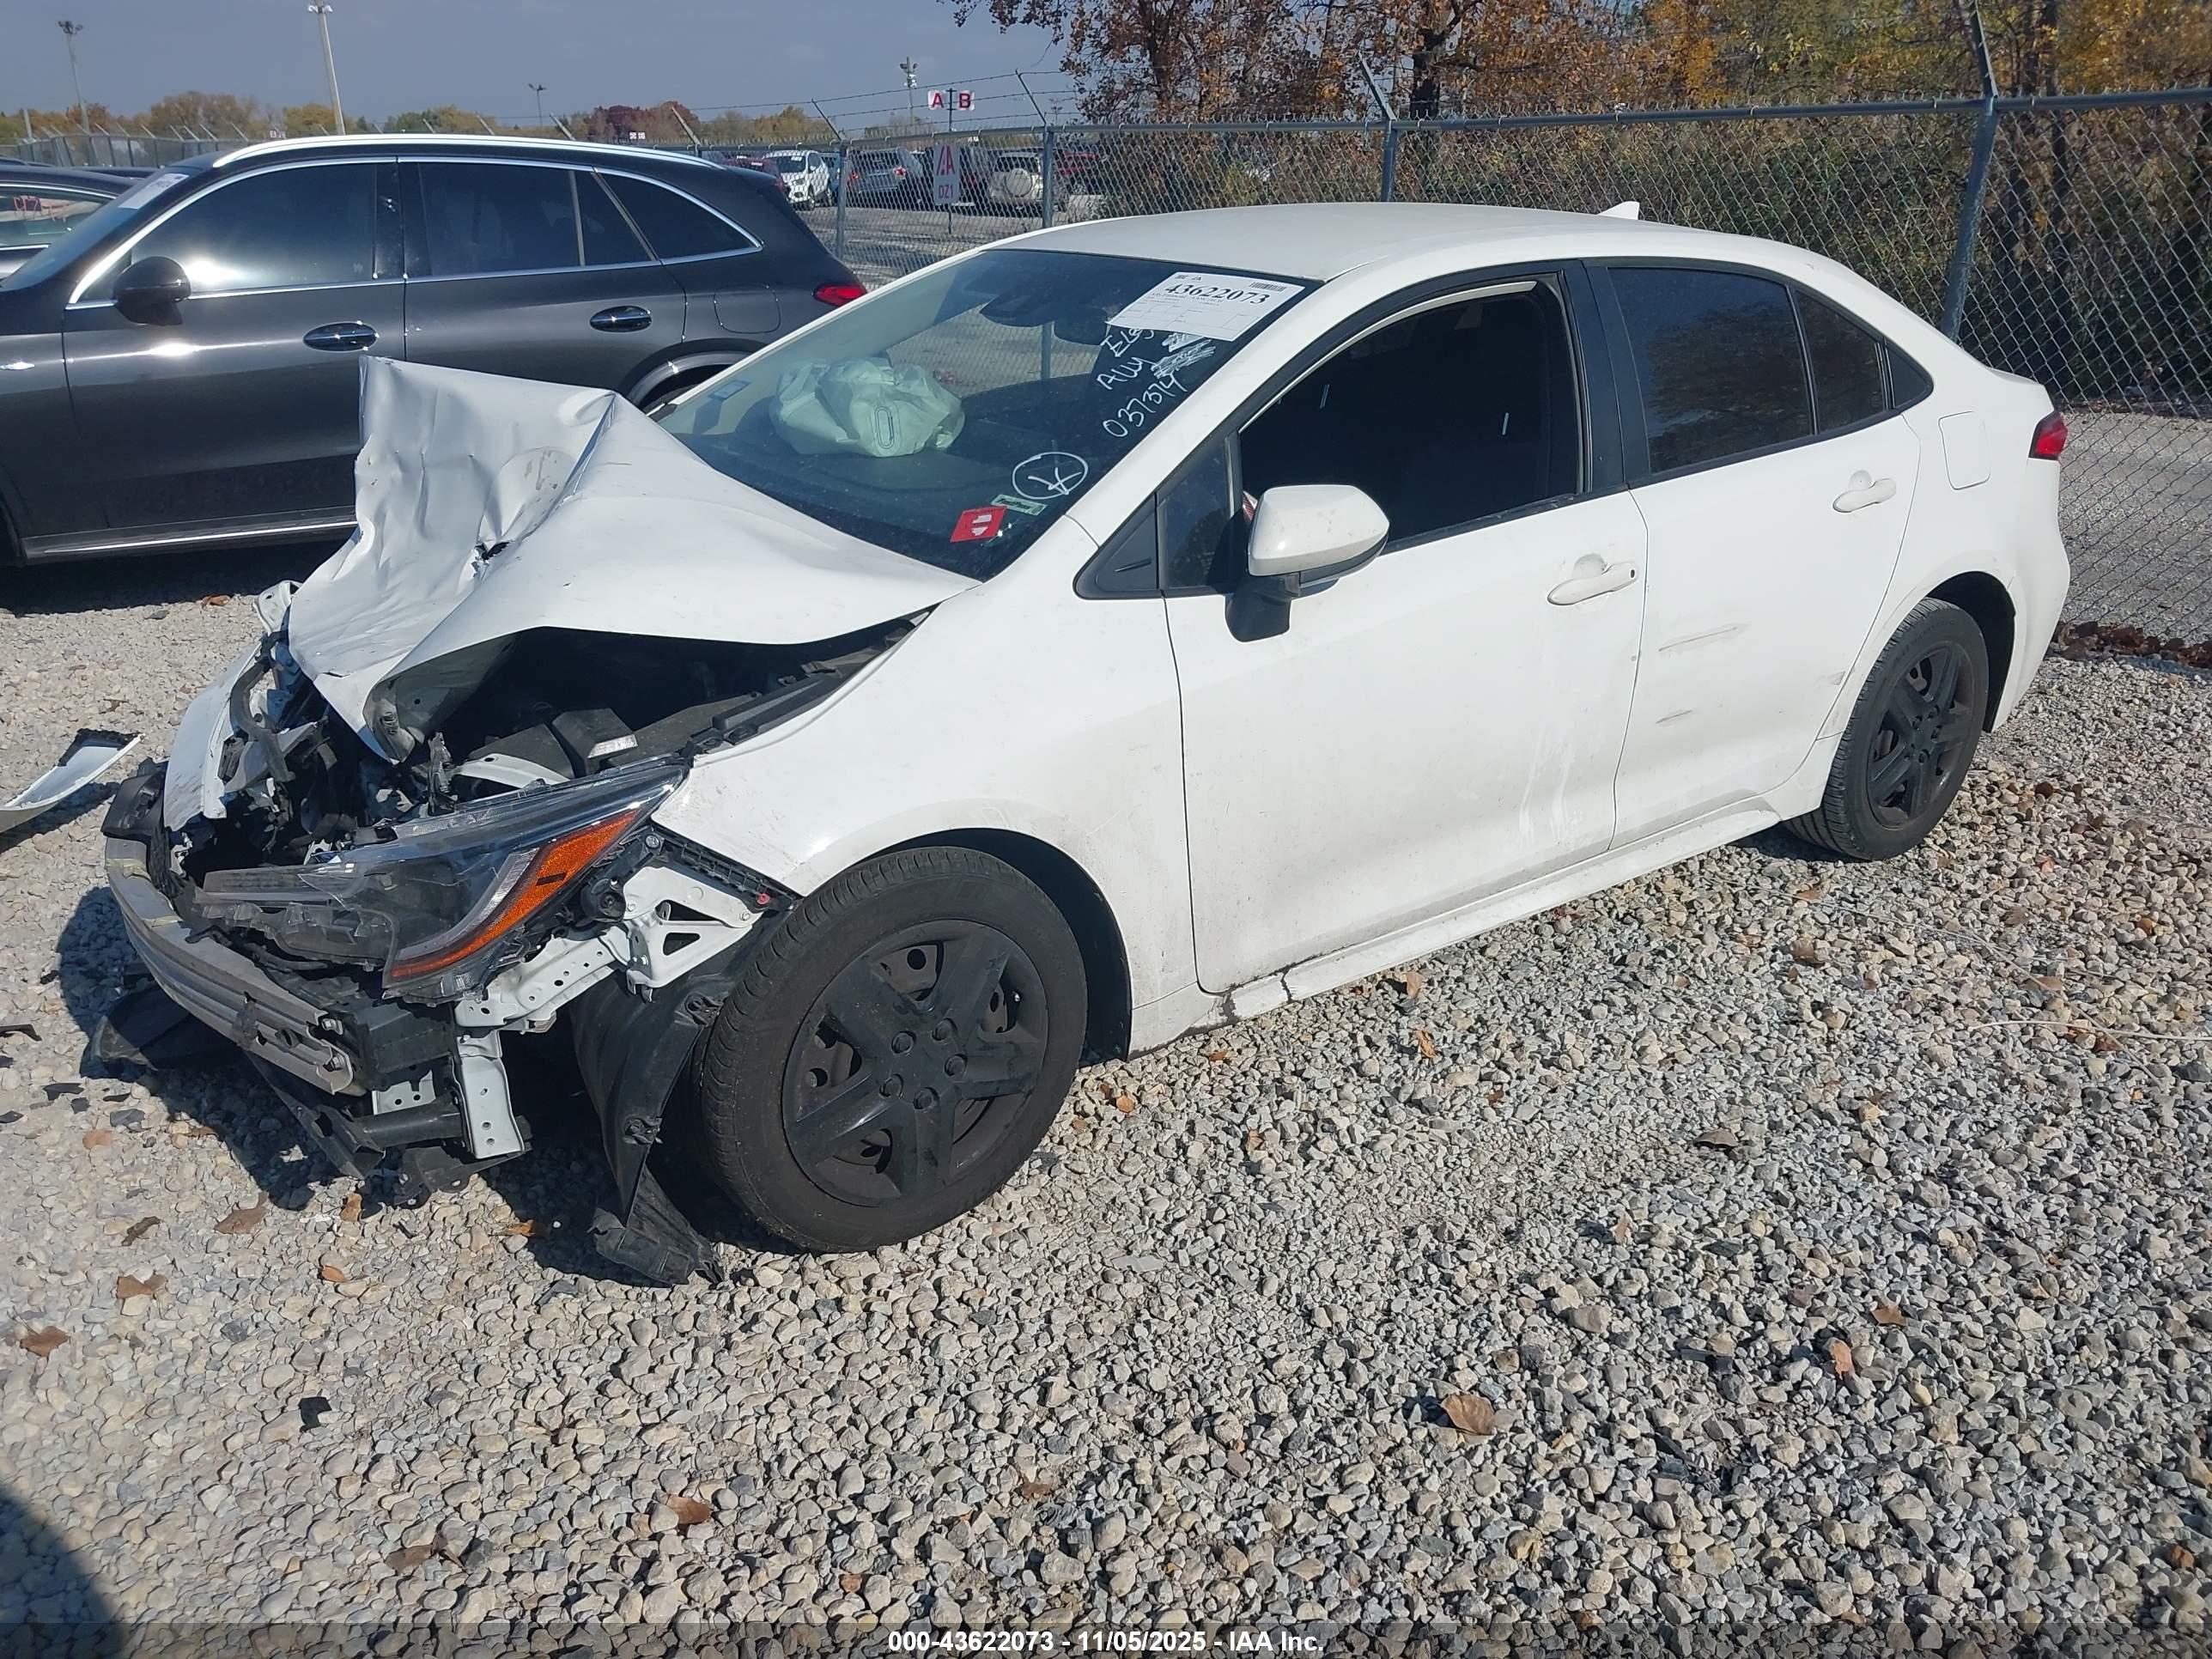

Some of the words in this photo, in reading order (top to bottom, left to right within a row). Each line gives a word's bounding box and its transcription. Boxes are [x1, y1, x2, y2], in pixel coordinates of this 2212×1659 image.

[932, 93, 944, 108] A
[959, 93, 971, 108] B
[1165, 283, 1270, 304] 43622073
